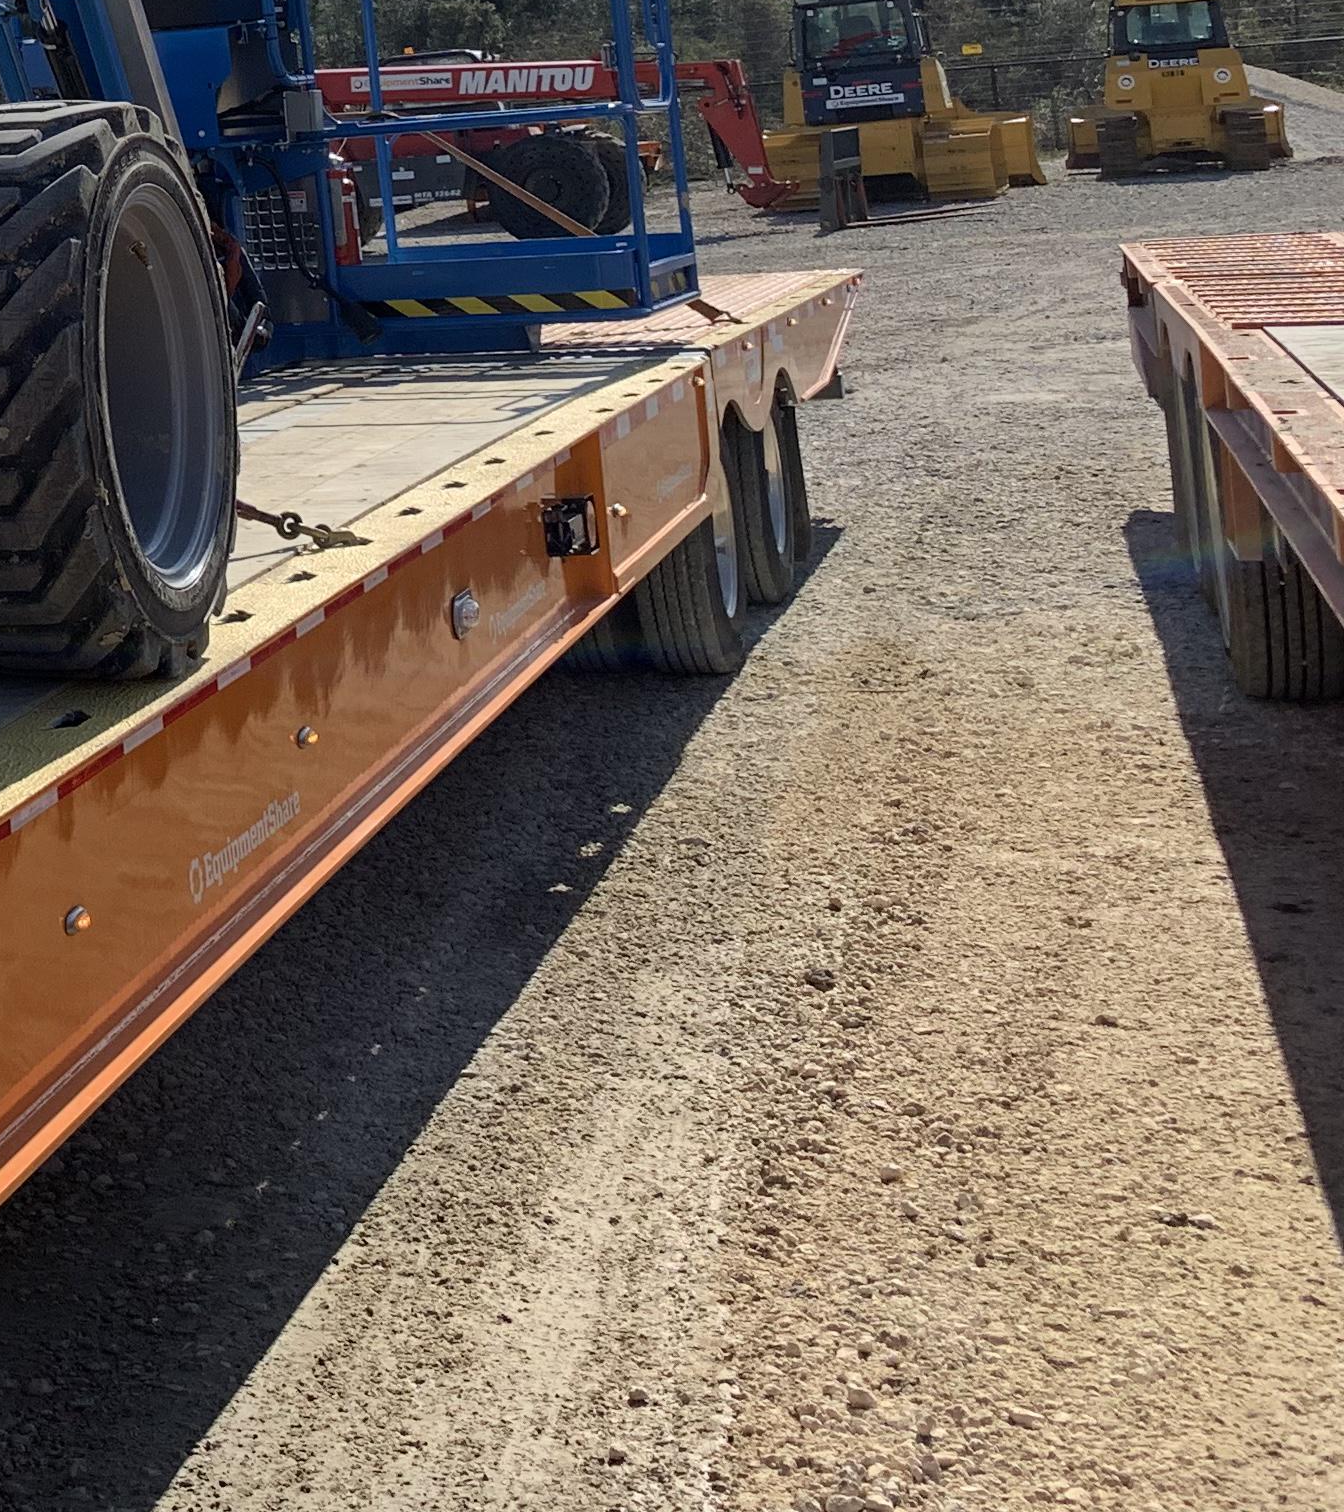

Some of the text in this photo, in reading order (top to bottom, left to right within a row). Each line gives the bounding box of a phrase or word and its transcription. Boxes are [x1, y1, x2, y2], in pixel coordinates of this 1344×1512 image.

[1148, 57, 1199, 68] DEERE
[459, 67, 595, 95] MANITOU
[829, 82, 893, 99] DEERE
[203, 791, 300, 888] EquipmentShare
